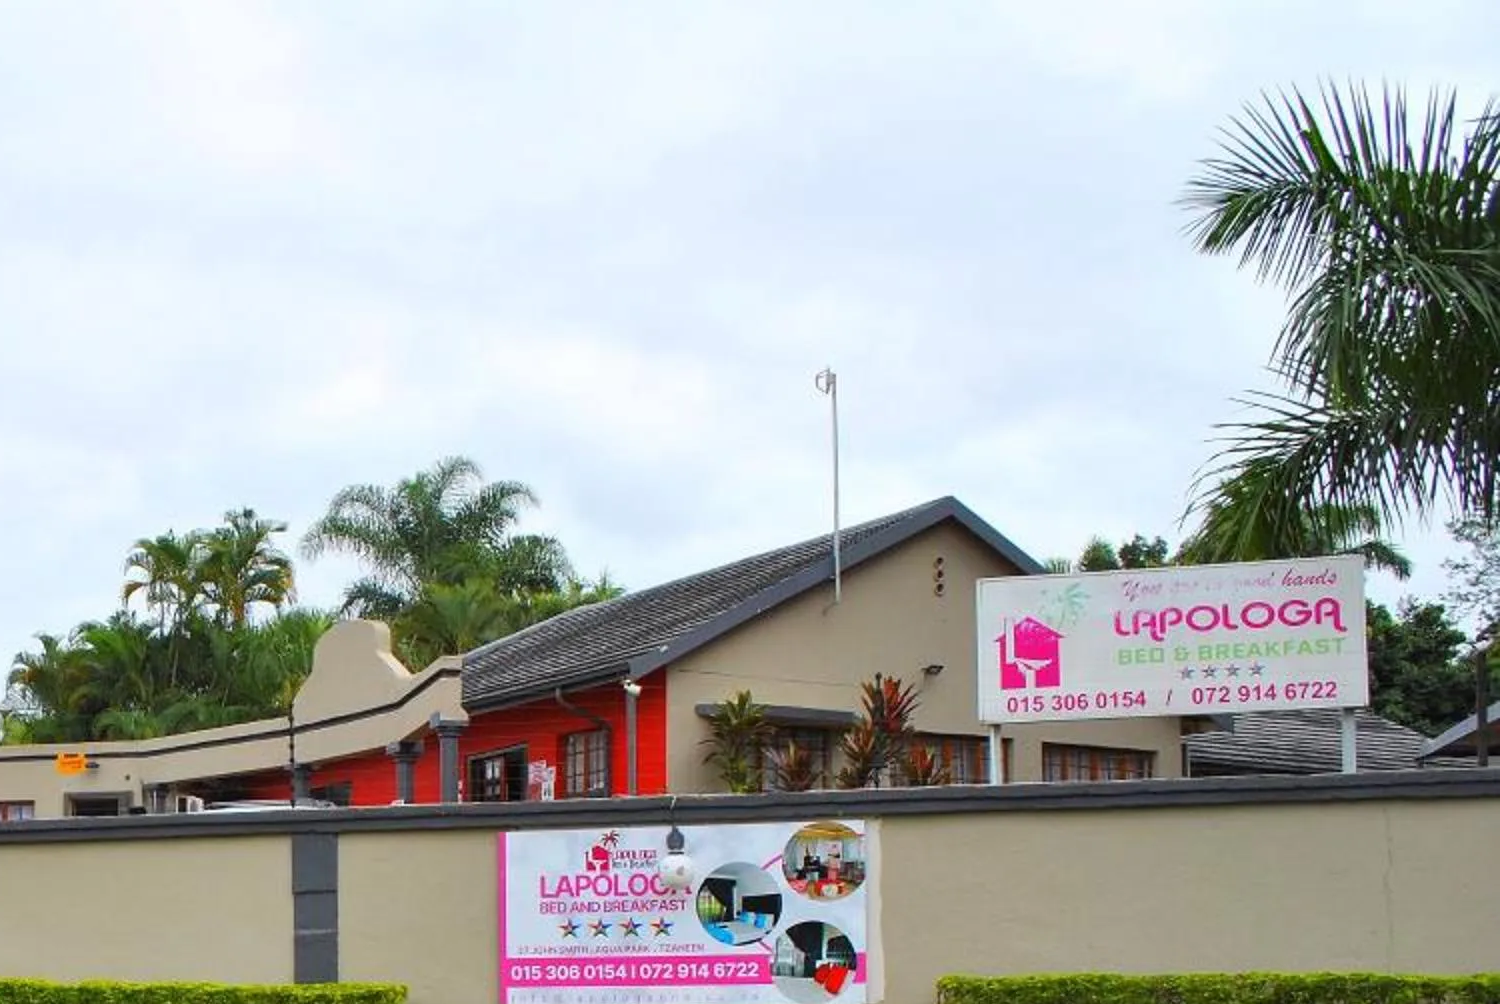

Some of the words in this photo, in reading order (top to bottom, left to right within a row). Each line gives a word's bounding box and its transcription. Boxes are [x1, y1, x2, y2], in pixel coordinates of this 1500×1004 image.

[1281, 567, 1338, 587] hands
[1113, 597, 1348, 642] LAPOLOGA
[1117, 647, 1165, 665] BED
[1174, 646, 1190, 662] &
[1197, 636, 1348, 661] BREAKFAST
[1006, 696, 1044, 713] 015
[1051, 693, 1089, 711] 306
[1095, 690, 1147, 709] 0154
[1165, 689, 1173, 706] /
[1191, 686, 1231, 705] 072
[1237, 683, 1279, 702] 914
[1284, 680, 1338, 700] 6722
[540, 873, 693, 898] LAPOLOG
[540, 901, 567, 915] BED
[570, 900, 601, 914] AND
[603, 898, 687, 913] BREAKFAST
[511, 965, 543, 981] 015
[546, 965, 580, 980] 306
[584, 964, 627, 980] 0154
[639, 963, 674, 979] 072
[677, 963, 710, 978] 914
[713, 961, 760, 978] 6722
